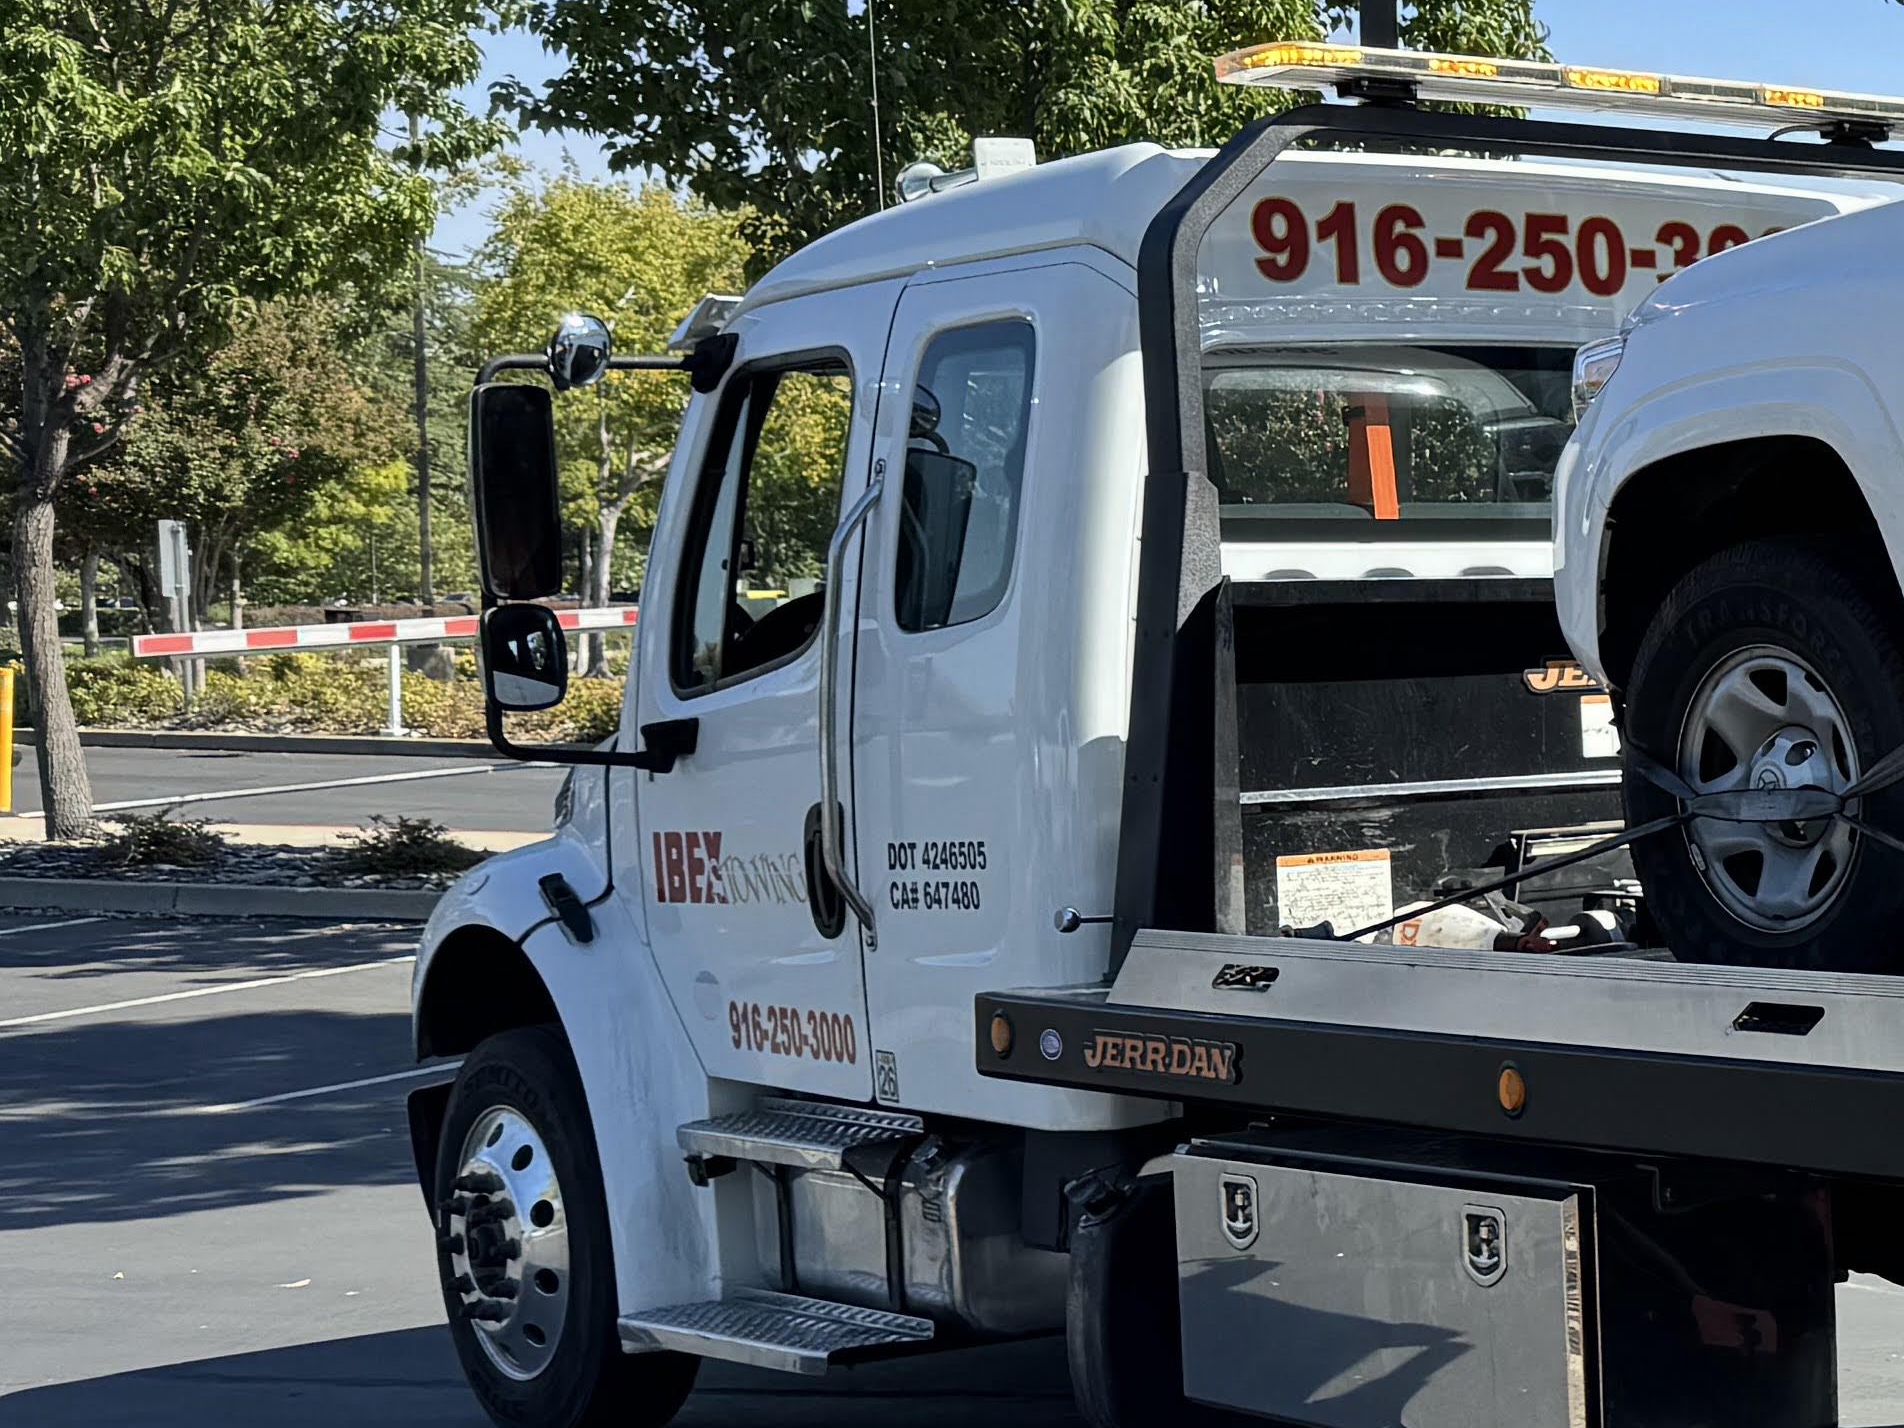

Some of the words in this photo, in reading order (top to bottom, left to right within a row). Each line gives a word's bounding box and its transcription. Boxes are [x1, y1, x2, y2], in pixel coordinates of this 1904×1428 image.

[1249, 195, 1791, 297] 916-250-3
[1526, 659, 1596, 690] JE
[652, 831, 729, 904] IBEX
[722, 853, 809, 905] TOWING
[887, 840, 917, 871] DOT
[921, 840, 988, 871] 4246505
[889, 881, 919, 910] CA#
[923, 882, 981, 910] 647480
[728, 999, 857, 1065] 916-250-3000
[878, 1064, 896, 1097] 26
